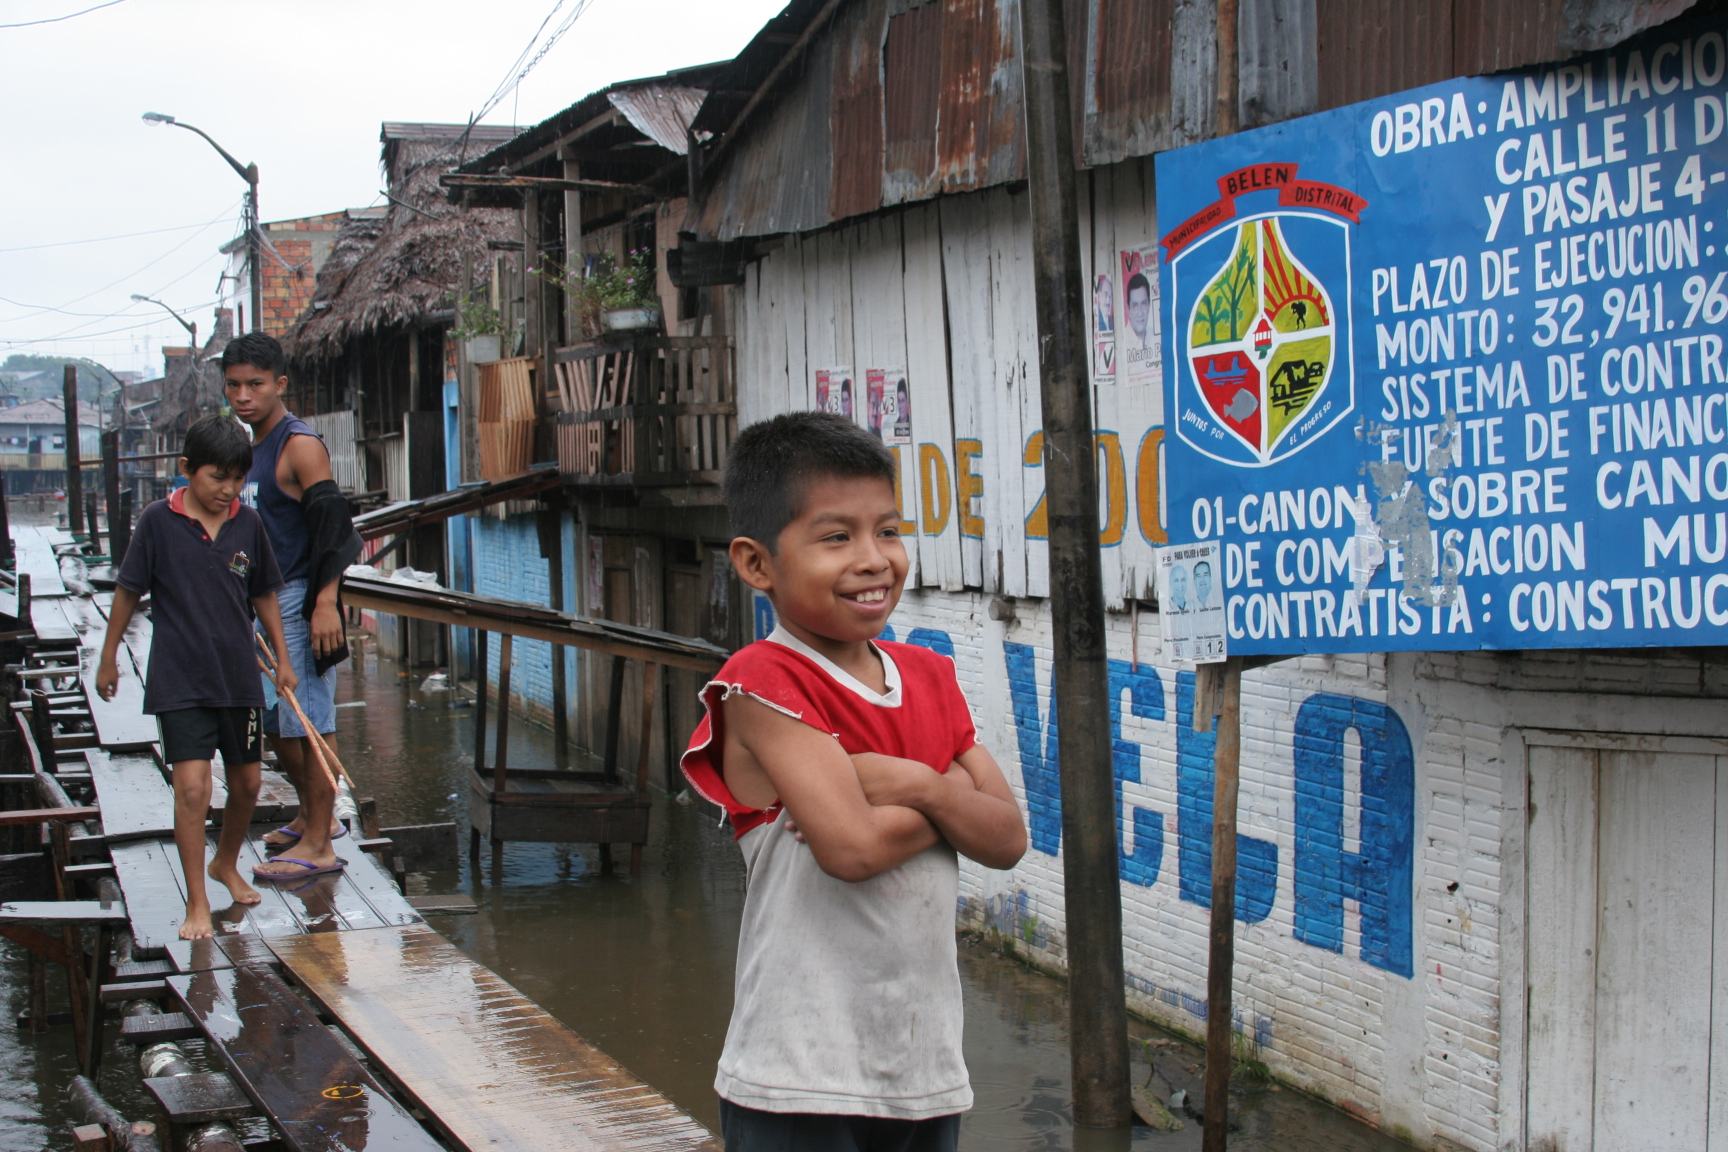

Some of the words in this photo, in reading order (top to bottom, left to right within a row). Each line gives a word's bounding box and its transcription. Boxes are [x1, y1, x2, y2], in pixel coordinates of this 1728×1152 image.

[1371, 92, 1486, 157] OBRA:
[1497, 31, 1728, 133] AMPLIACIO
[1496, 113, 1627, 185] CALLE
[1643, 102, 1678, 155] 11
[1694, 88, 1728, 146] D
[1228, 167, 1289, 195] BELEN
[1295, 186, 1355, 214] DISTRITAL
[1522, 161, 1663, 236] PASAJE
[1169, 207, 1222, 247] MUNICIPALIDAD
[1373, 255, 1467, 316] PLAZO
[1481, 247, 1520, 300] DE
[1535, 215, 1715, 292] EJECUCION:
[1127, 343, 1154, 364] Mario
[1376, 309, 1515, 370] MONTO:
[1531, 271, 1728, 348] 32,941.96
[1382, 358, 1530, 422] SISTEMA
[1548, 353, 1587, 405] DE
[1600, 334, 1728, 396] CONTR
[1182, 408, 1209, 432] JUNTOS
[1210, 427, 1225, 441] POR
[1289, 433, 1297, 446] EL
[1300, 401, 1332, 435] PROGRESO
[1525, 407, 1570, 463] DE
[1590, 390, 1728, 455] FINANC
[918, 438, 986, 540] DE
[1192, 484, 1367, 539] 01-CANON
[1427, 465, 1567, 521] SOBRE
[1596, 453, 1728, 510] CANO
[1227, 541, 1263, 588] DE
[1643, 512, 1728, 568] MU
[1227, 584, 1491, 640] CONTRATISTA:
[1509, 574, 1728, 633] CONSTRUC
[1003, 640, 1415, 981] VELA
